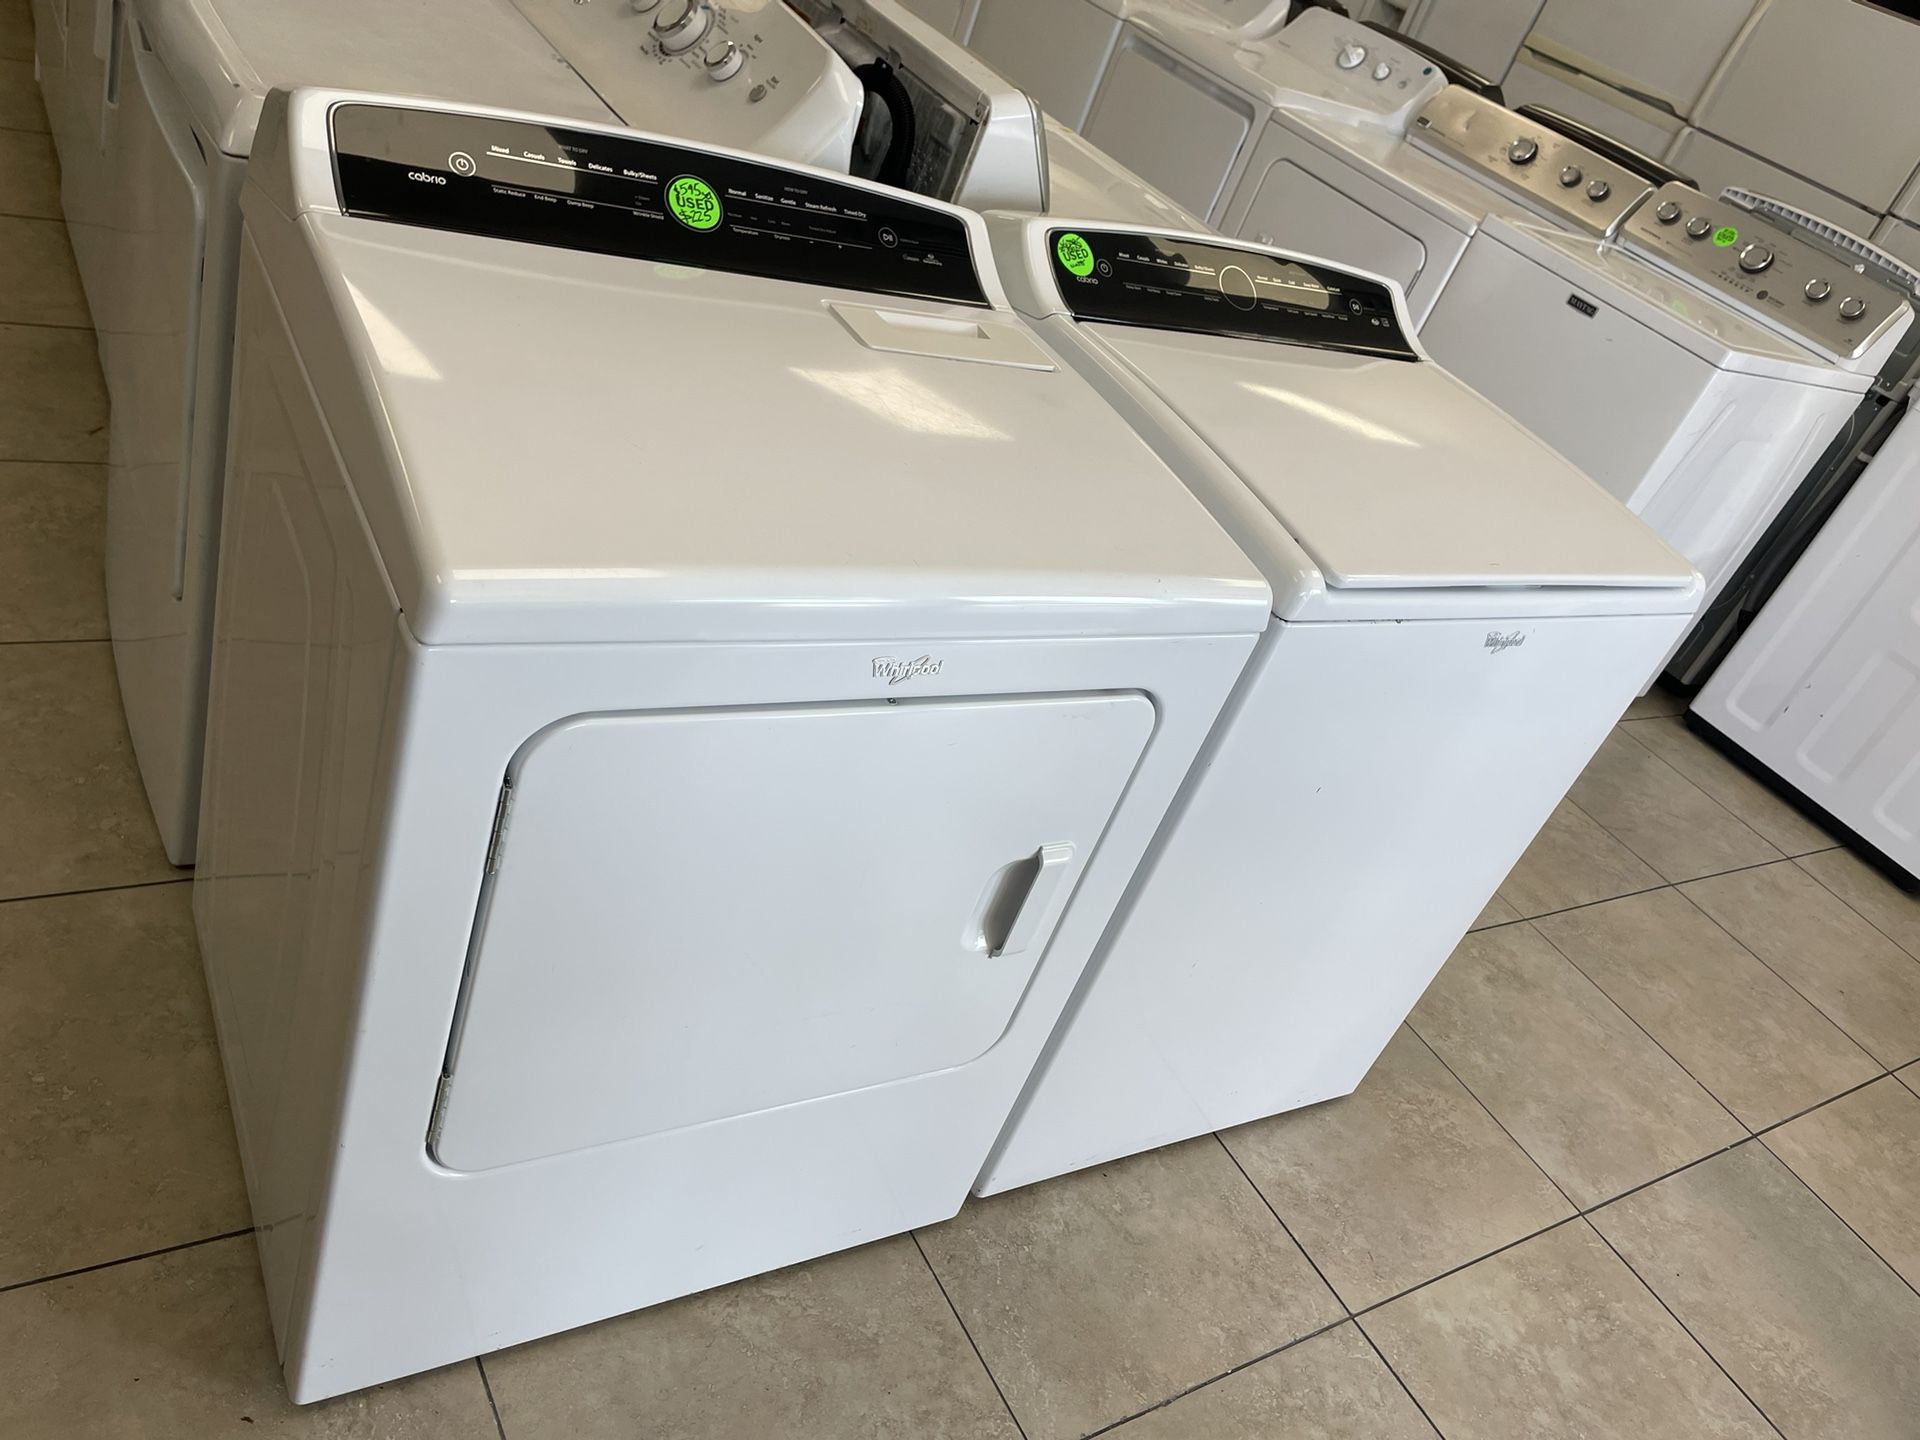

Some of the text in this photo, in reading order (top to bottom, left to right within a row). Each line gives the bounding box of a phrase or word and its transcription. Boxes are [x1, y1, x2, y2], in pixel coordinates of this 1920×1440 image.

[491, 145, 510, 154] Mixed
[523, 151, 546, 161] Casuals
[588, 163, 613, 173] Delicates
[408, 171, 447, 185] cabrio
[623, 169, 657, 181] Bulky/Sheets
[728, 188, 747, 197] Normal
[755, 193, 774, 202] Sanitize
[676, 195, 714, 211] USED
[780, 198, 796, 206] Gentle
[857, 211, 867, 219] Dry
[1062, 248, 1089, 262] USED
[1484, 631, 1525, 654] Whirlpool
[872, 655, 943, 685] Whirlpool
